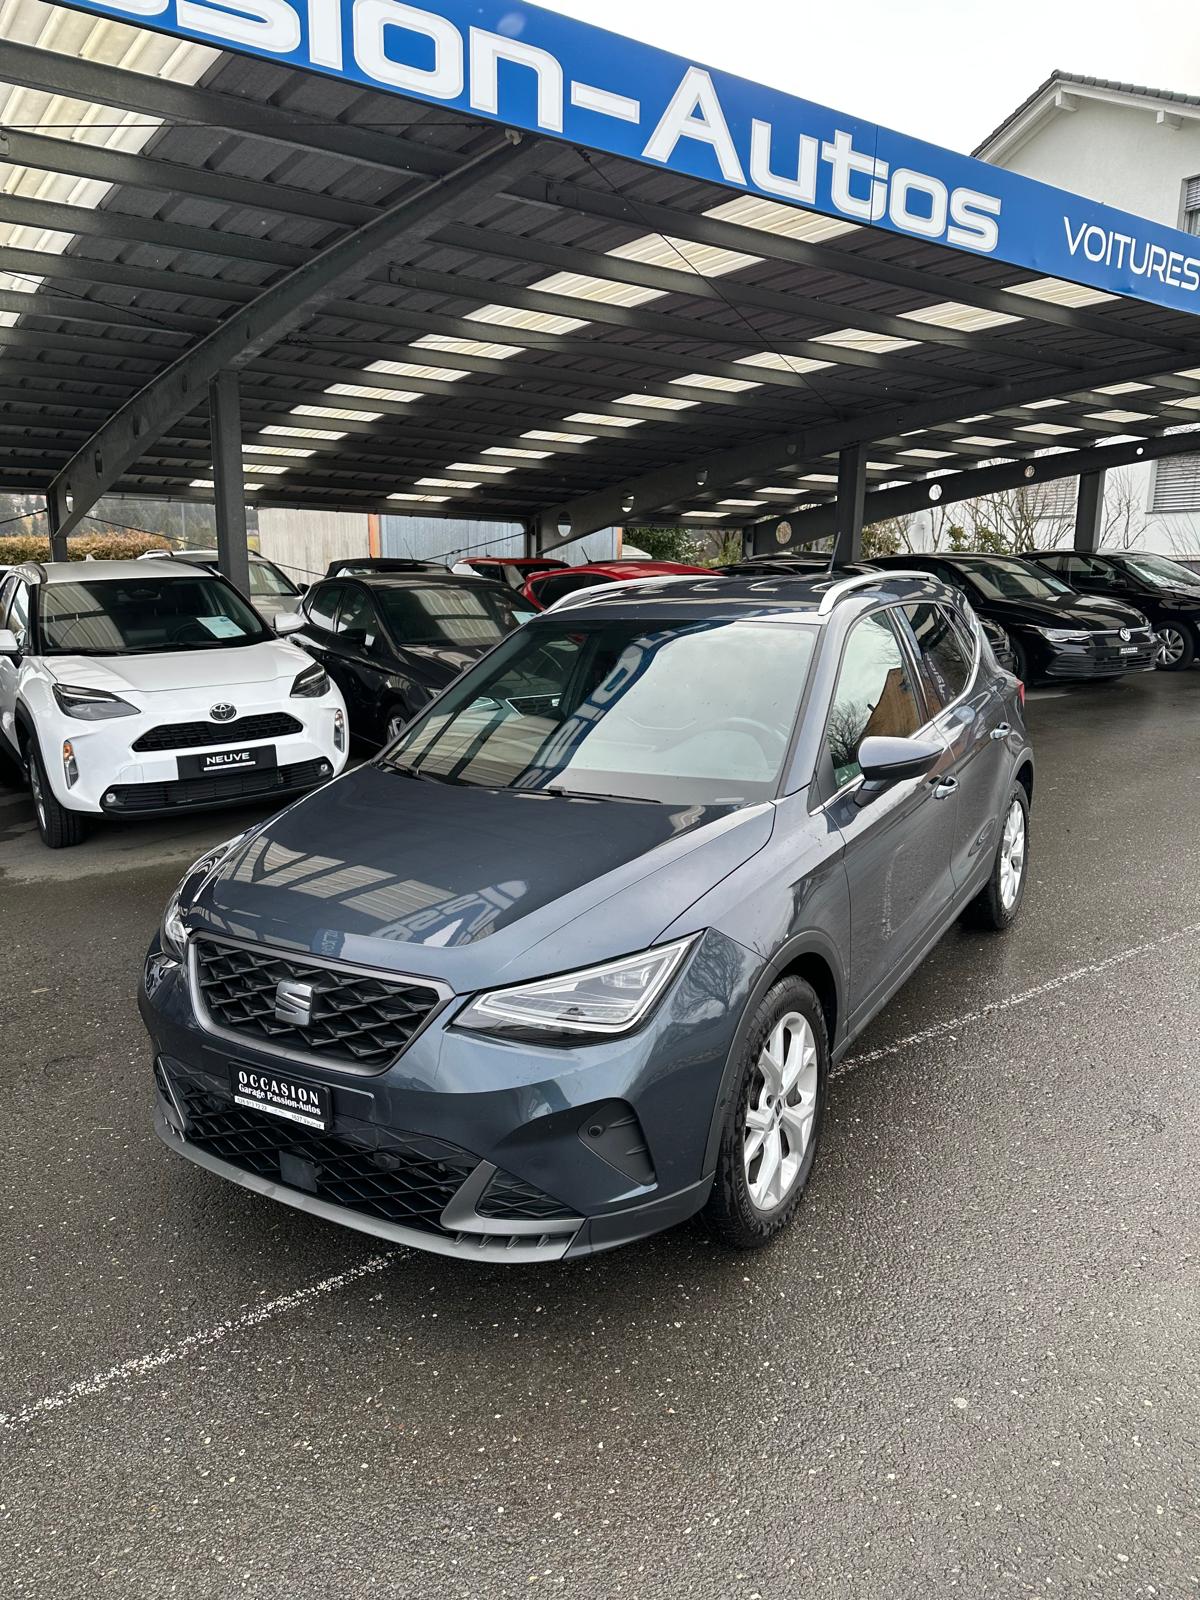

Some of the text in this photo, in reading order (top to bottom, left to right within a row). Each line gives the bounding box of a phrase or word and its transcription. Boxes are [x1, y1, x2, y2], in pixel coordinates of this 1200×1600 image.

[1063, 216, 1200, 291] VOITURES
[206, 752, 250, 765] NEUVE
[239, 1071, 319, 1105] OCCASION
[239, 1084, 265, 1099] Garage
[267, 1091, 321, 1115] Passion-Autos
